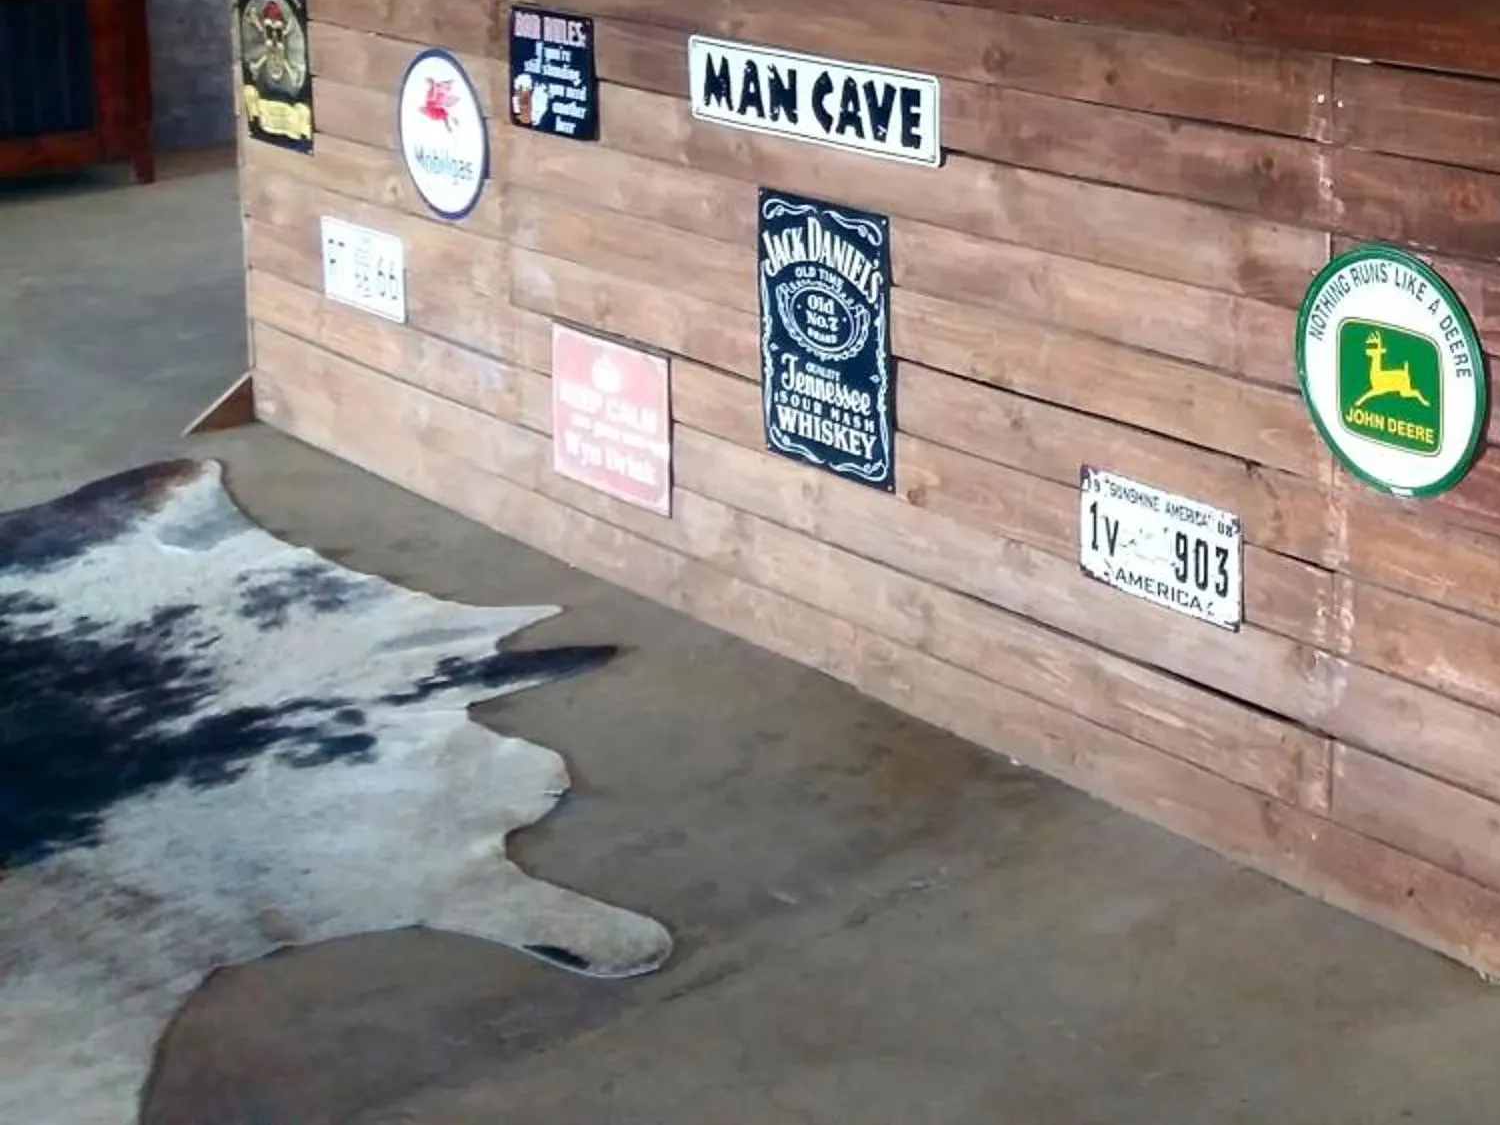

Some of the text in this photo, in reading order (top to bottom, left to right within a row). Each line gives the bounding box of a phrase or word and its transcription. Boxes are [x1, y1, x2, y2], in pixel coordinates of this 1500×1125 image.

[704, 52, 921, 149] MAN CAVE
[762, 216, 884, 304] JACK DANIEL'S
[807, 295, 835, 315] Old
[1308, 262, 1473, 379] NOTHING RUNS LIKE A DEERE
[779, 390, 876, 433] SOUR MASH
[780, 352, 872, 416] Tennessee
[775, 404, 877, 460] WHISKEY
[1345, 406, 1435, 445] JOHN DEERE
[1114, 566, 1204, 612] AMERICA
[1174, 530, 1229, 599] 903
